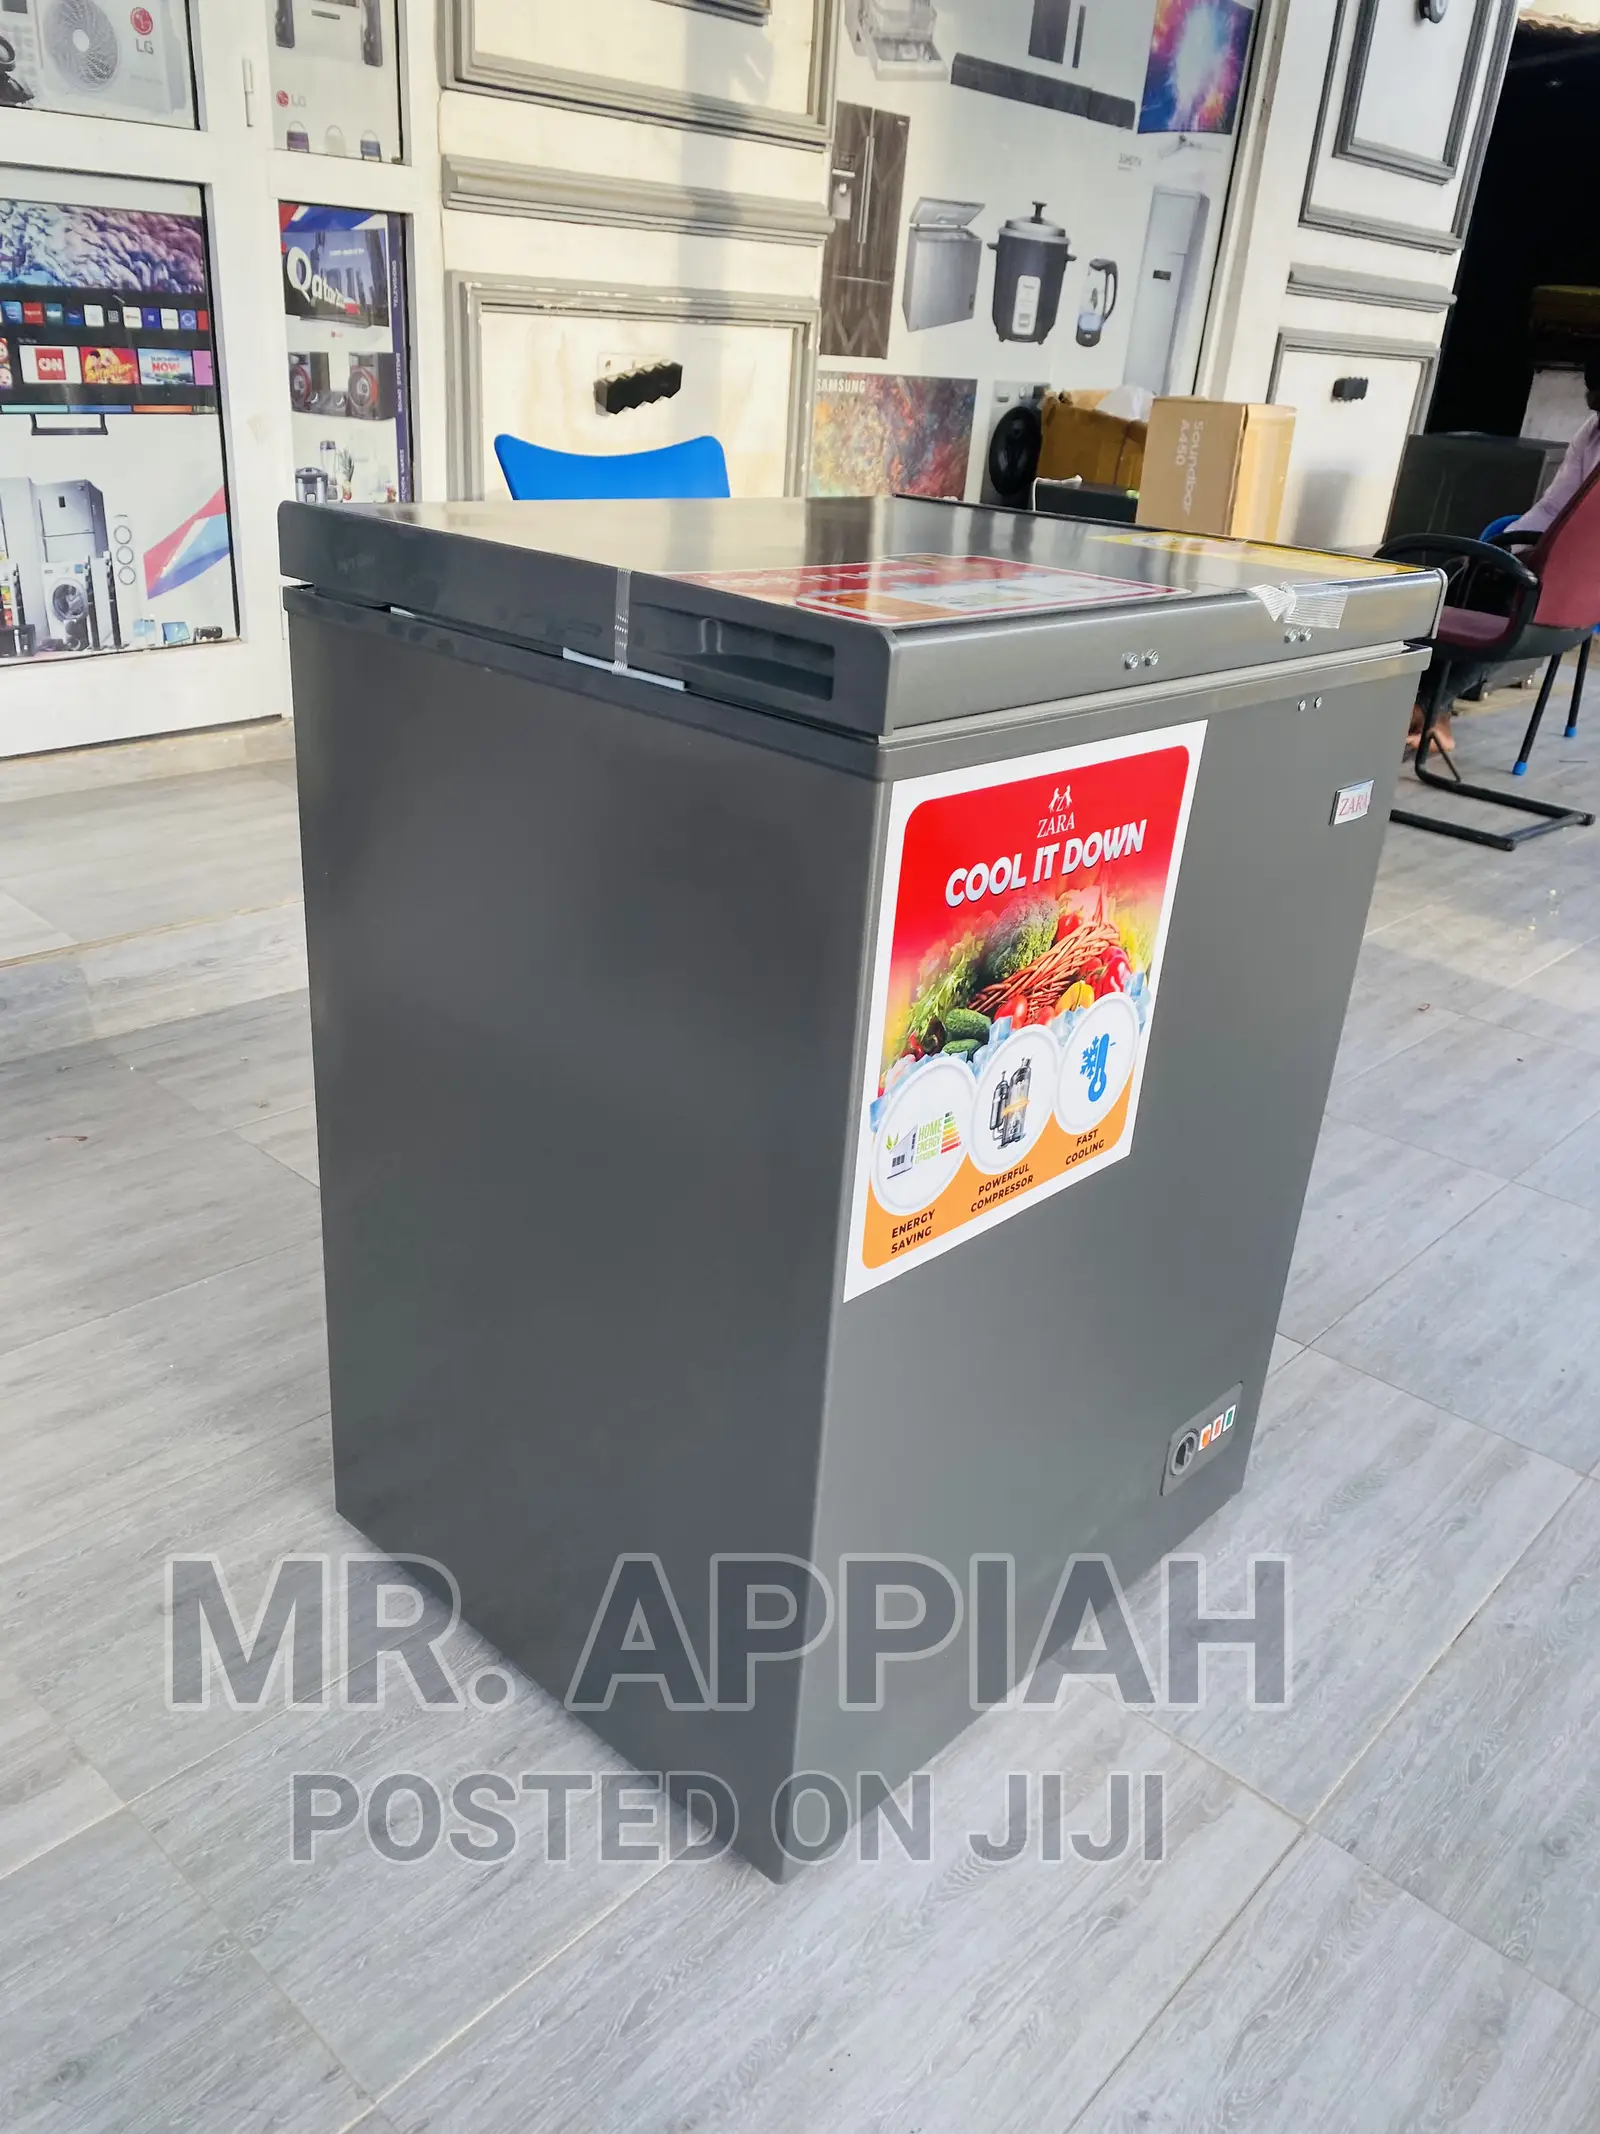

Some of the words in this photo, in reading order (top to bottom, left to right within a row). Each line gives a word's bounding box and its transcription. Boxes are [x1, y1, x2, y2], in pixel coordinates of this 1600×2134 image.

[135, 38, 154, 55] LG
[291, 94, 307, 108] LG
[38, 357, 63, 372] CNN
[815, 378, 866, 394] SAMSUNG
[1175, 419, 1191, 466] A450
[1182, 419, 1205, 516] Soundbar
[1338, 791, 1369, 817] ZARA
[1036, 811, 1076, 839] ZARA
[945, 852, 1027, 908] COOL
[1032, 841, 1061, 885] IT
[1061, 818, 1149, 876] DOWN
[918, 1117, 943, 1142] HOME
[1076, 1128, 1099, 1147] FAST
[916, 1135, 941, 1154] ENERGY
[1065, 1139, 1105, 1166] COOLING
[978, 1163, 1030, 1196] POWERFUL
[970, 1174, 1034, 1213] COMPRESSOR
[891, 1208, 936, 1239] ENERGY
[890, 1226, 933, 1254] SAVING
